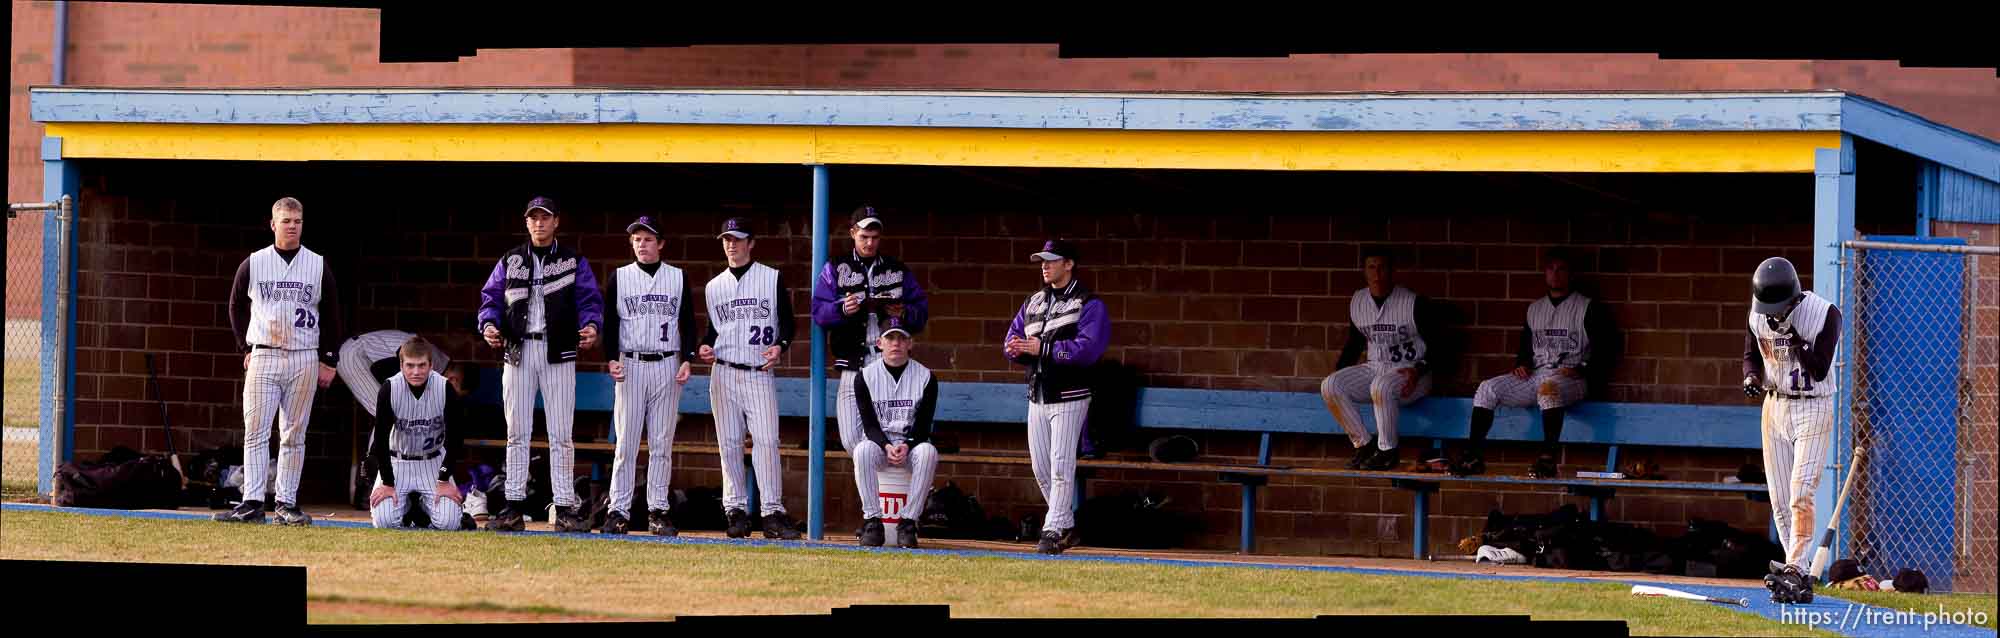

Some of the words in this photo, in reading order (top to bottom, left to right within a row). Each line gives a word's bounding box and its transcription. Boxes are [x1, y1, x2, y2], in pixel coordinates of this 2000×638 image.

[624, 296, 679, 316] WOLVES
[642, 294, 669, 302] SILVER
[731, 298, 758, 308] SILVER
[716, 299, 770, 325] WOLVES
[660, 321, 669, 342] 1
[749, 326, 774, 345] 28
[1389, 341, 1417, 363] 33
[1789, 368, 1814, 391] 11
